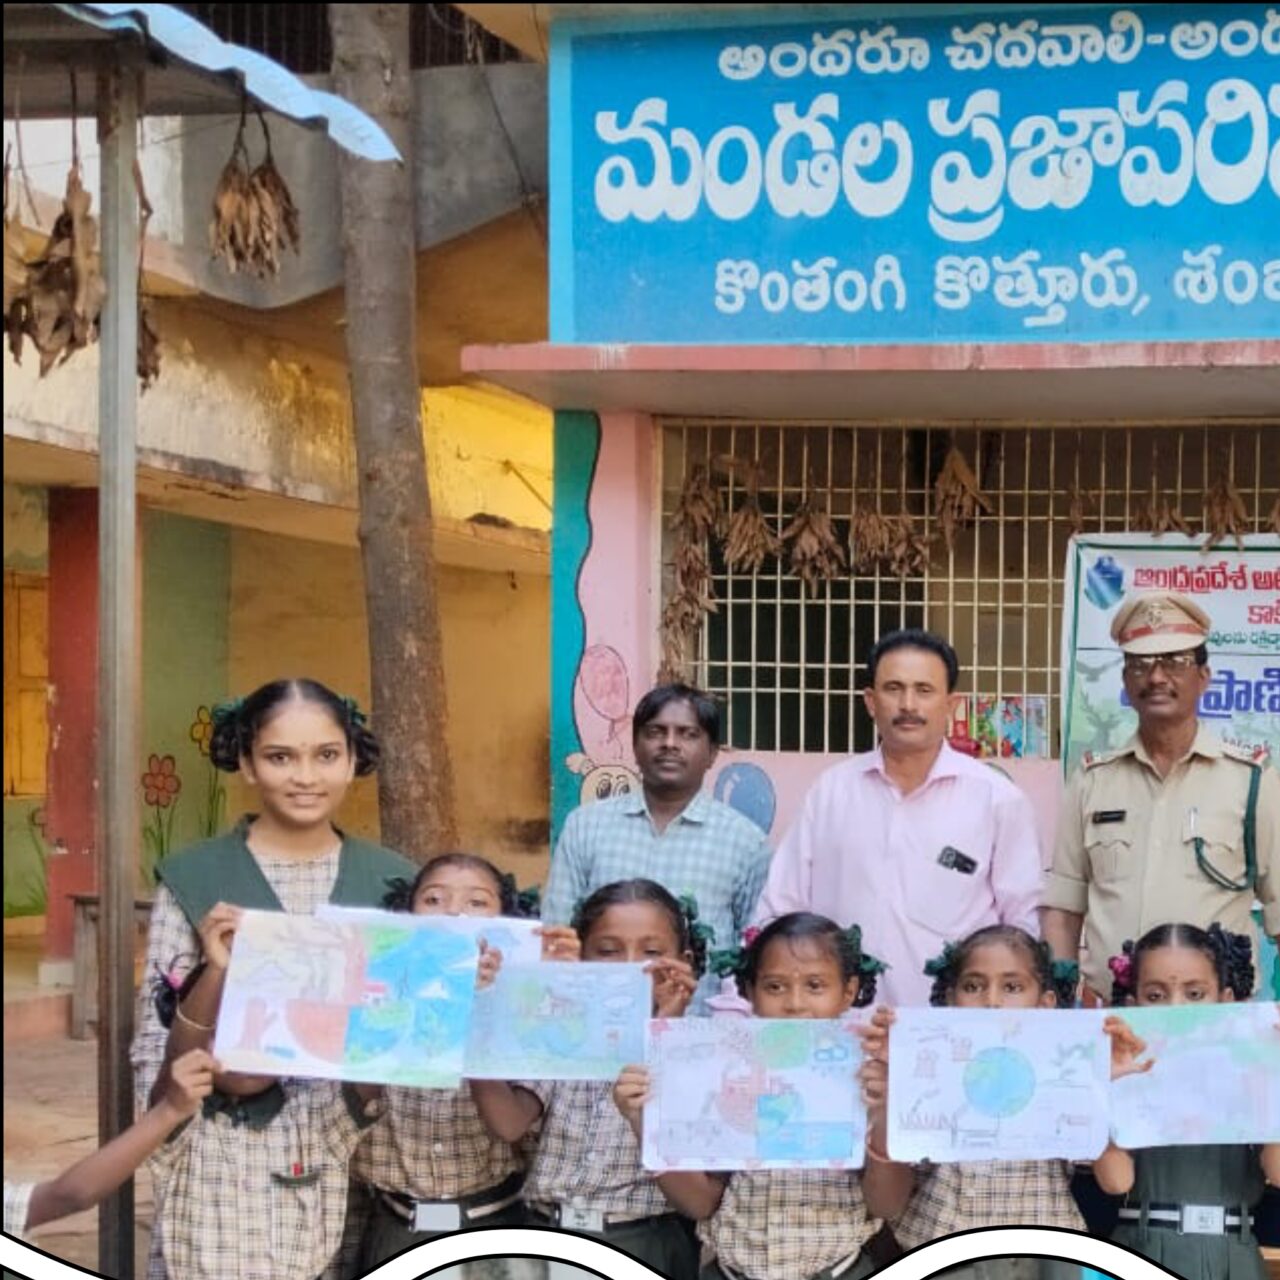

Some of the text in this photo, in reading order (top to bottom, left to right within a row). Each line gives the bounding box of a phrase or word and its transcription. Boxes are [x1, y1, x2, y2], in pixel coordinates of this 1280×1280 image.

[718, 27, 929, 81] అందరూ
[595, 94, 913, 223] మండల
[715, 255, 906, 313] కొంతంగి
